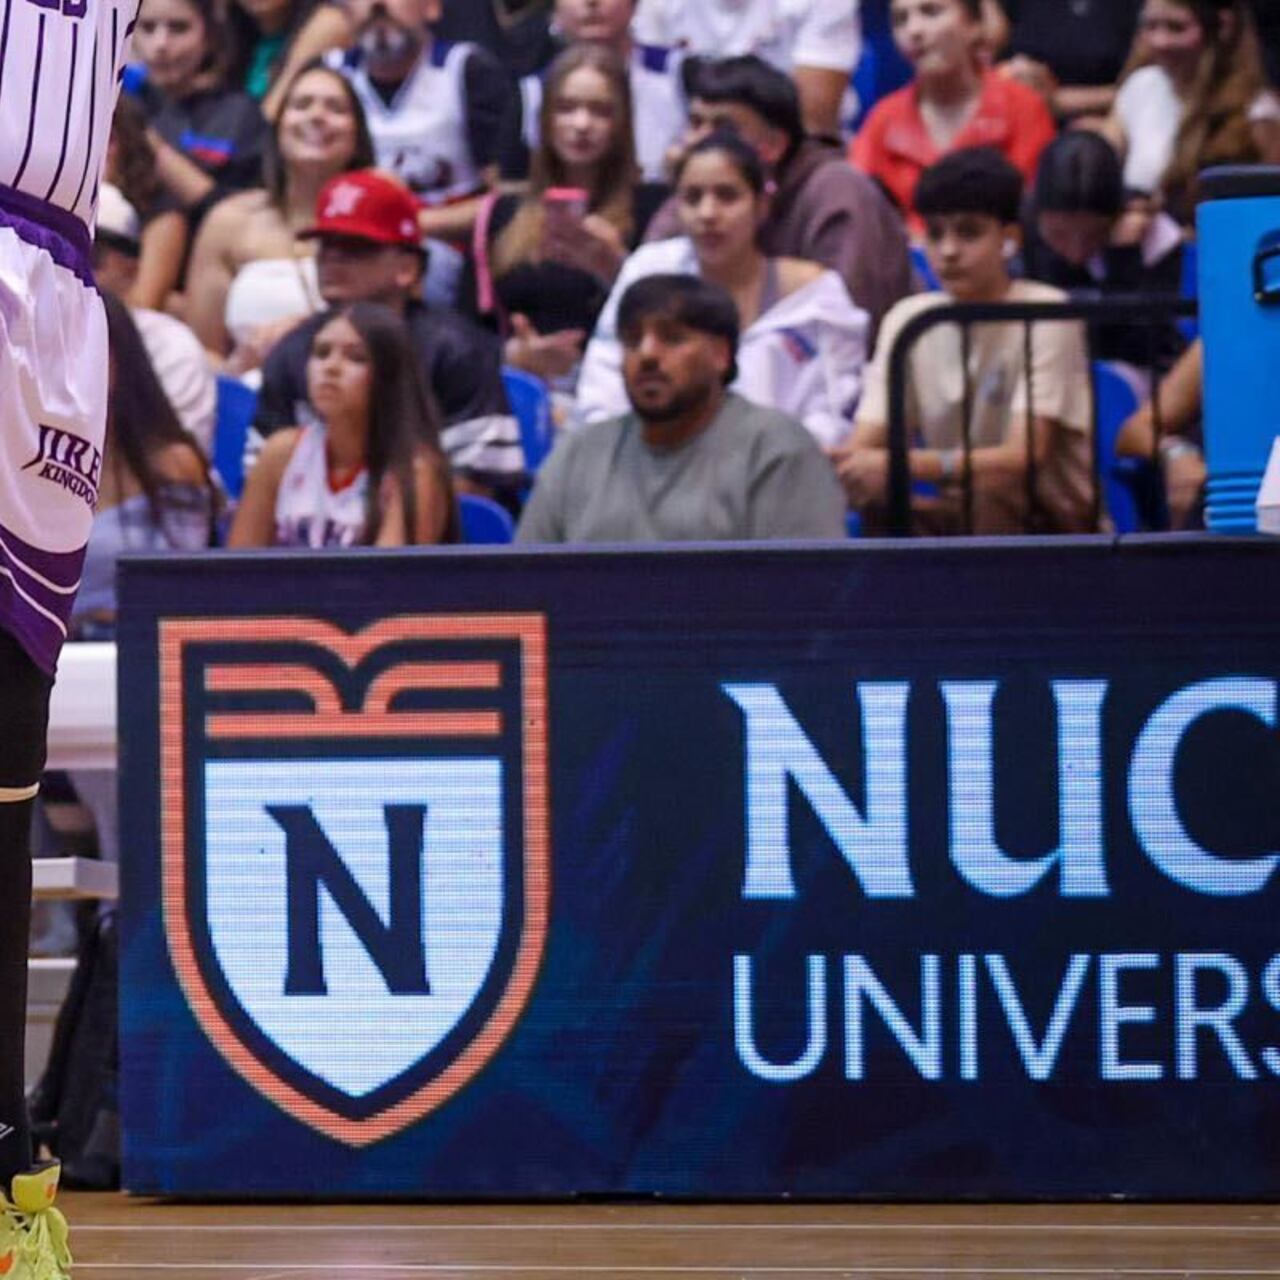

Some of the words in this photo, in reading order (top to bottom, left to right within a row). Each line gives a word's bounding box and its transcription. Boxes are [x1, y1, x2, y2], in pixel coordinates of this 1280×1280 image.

[38, 462, 97, 516] KINGDO
[722, 676, 1280, 899] NUC
[263, 803, 431, 997] N
